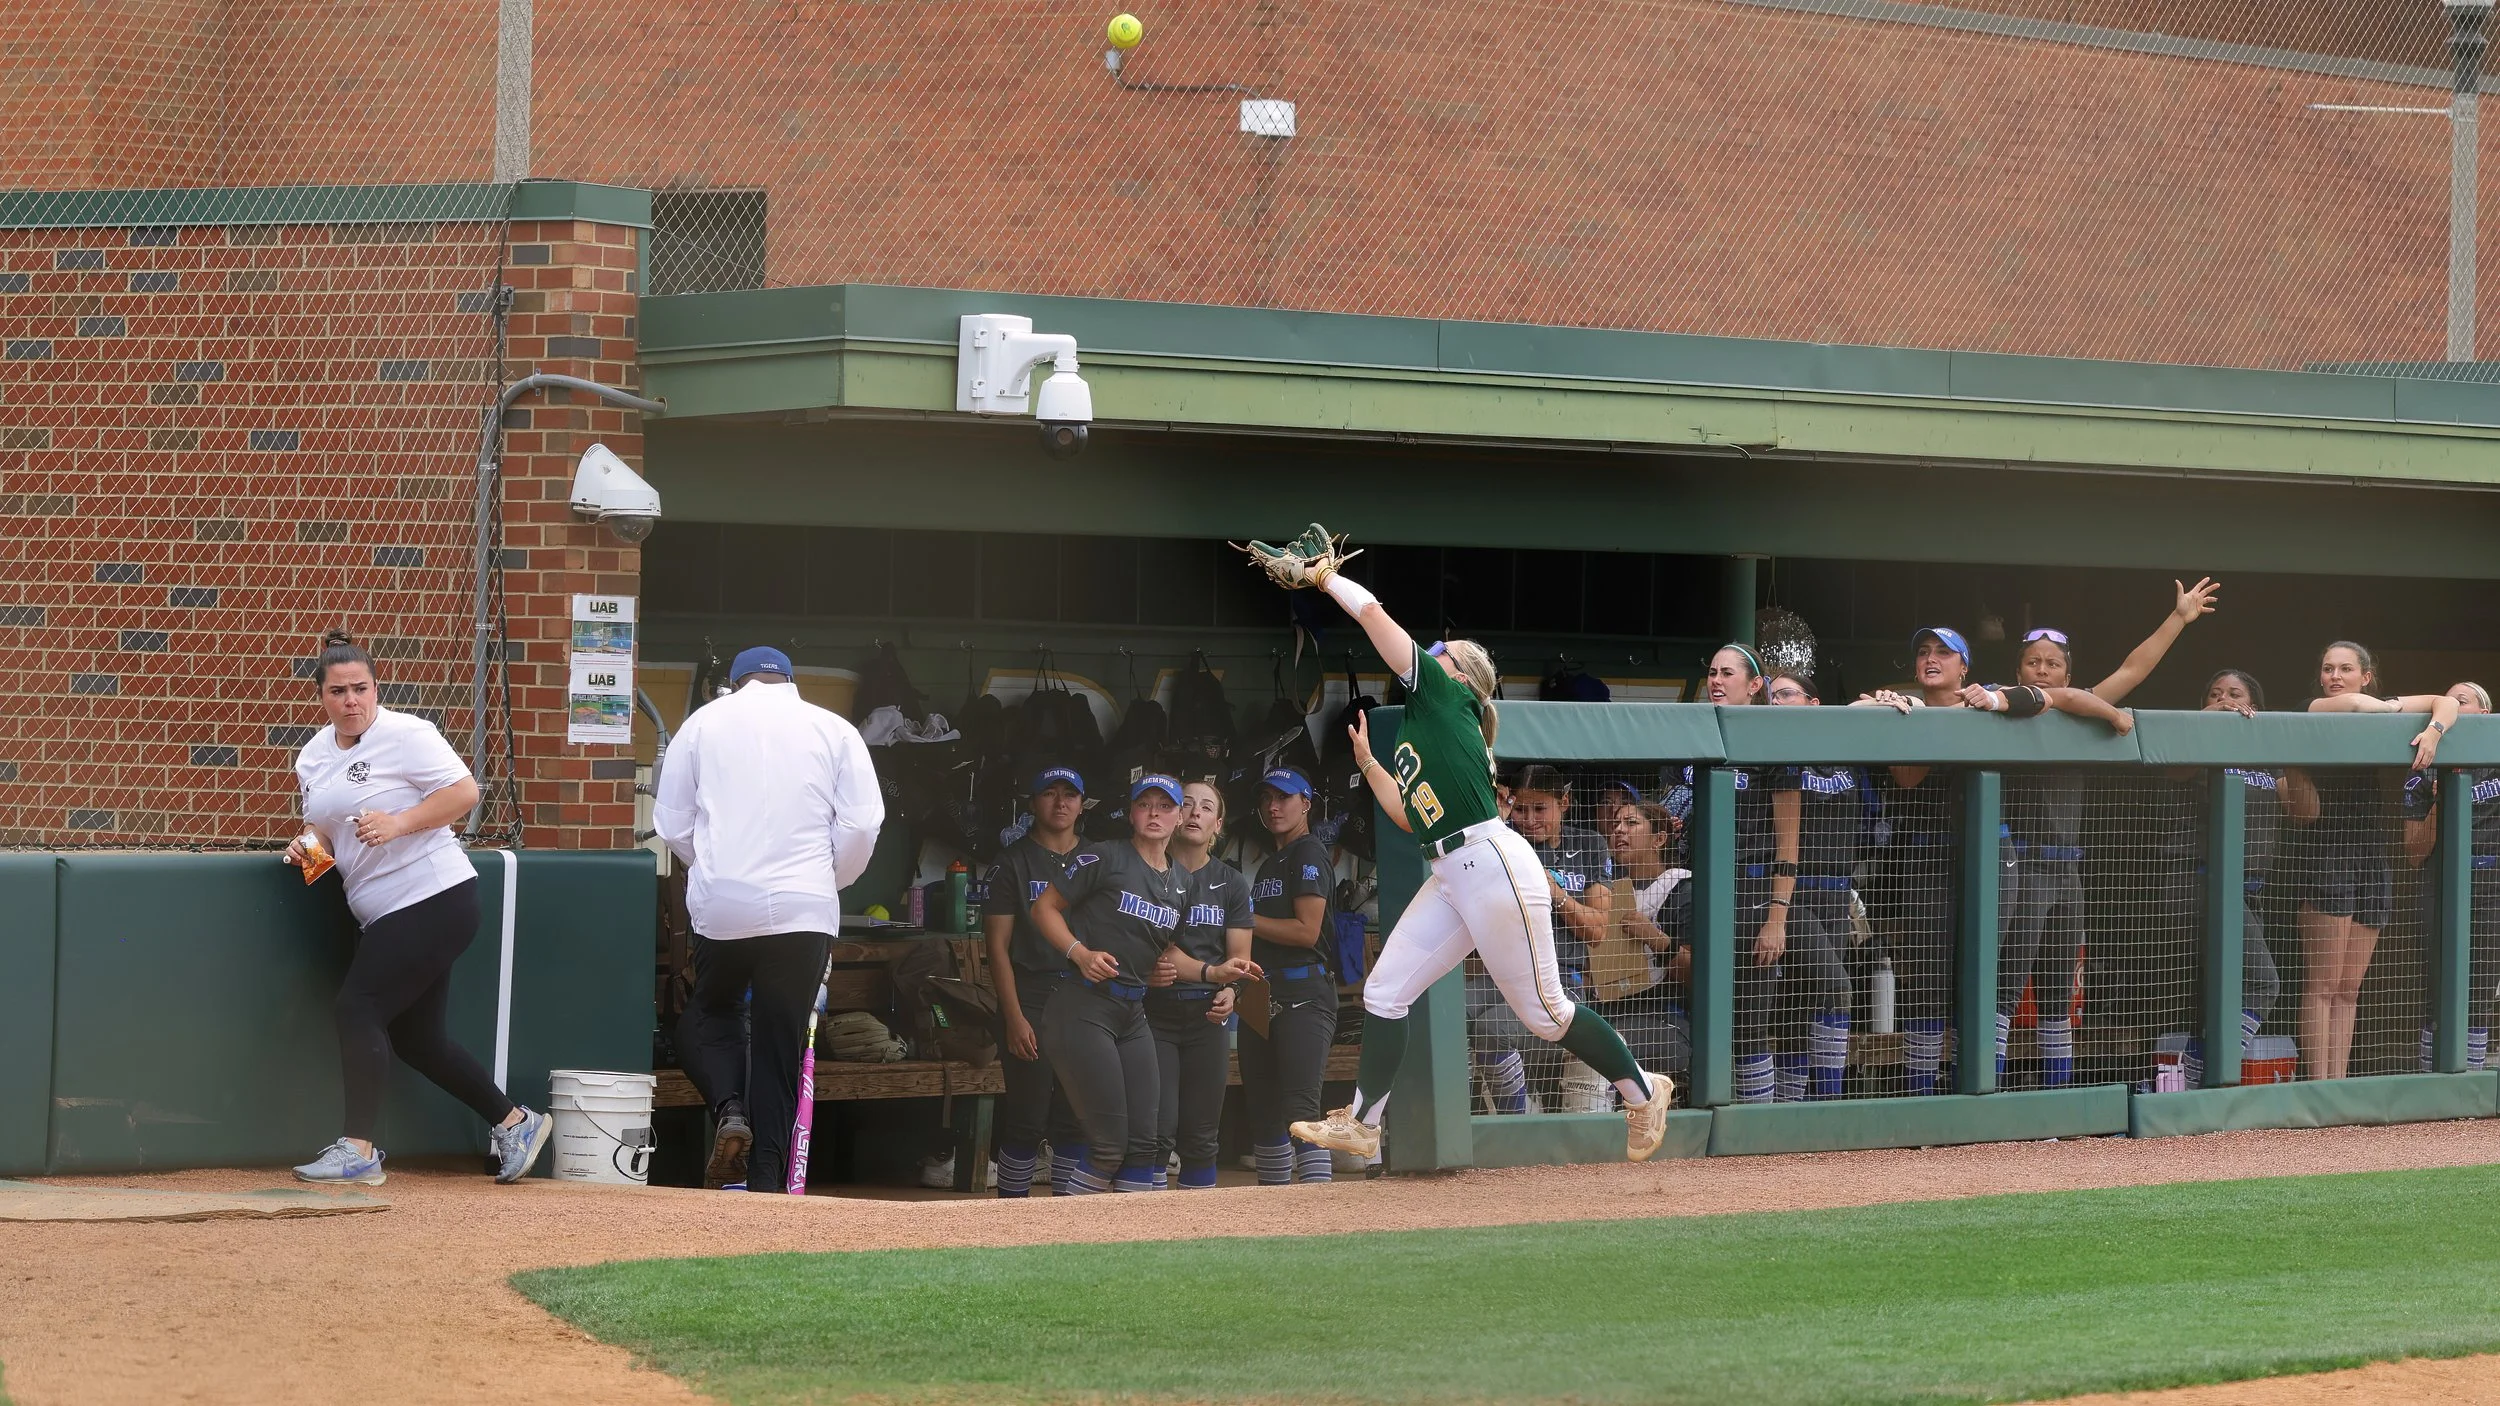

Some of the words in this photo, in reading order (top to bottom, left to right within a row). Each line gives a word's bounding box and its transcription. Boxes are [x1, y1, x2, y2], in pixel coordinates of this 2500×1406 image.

[590, 602, 618, 614] UAB
[588, 674, 616, 686] UAB
[1044, 770, 1075, 779] MEMPHIS
[1142, 777, 1175, 789] MEMPHIS
[1411, 781, 1445, 829] 19
[1186, 903, 1225, 927] phis
